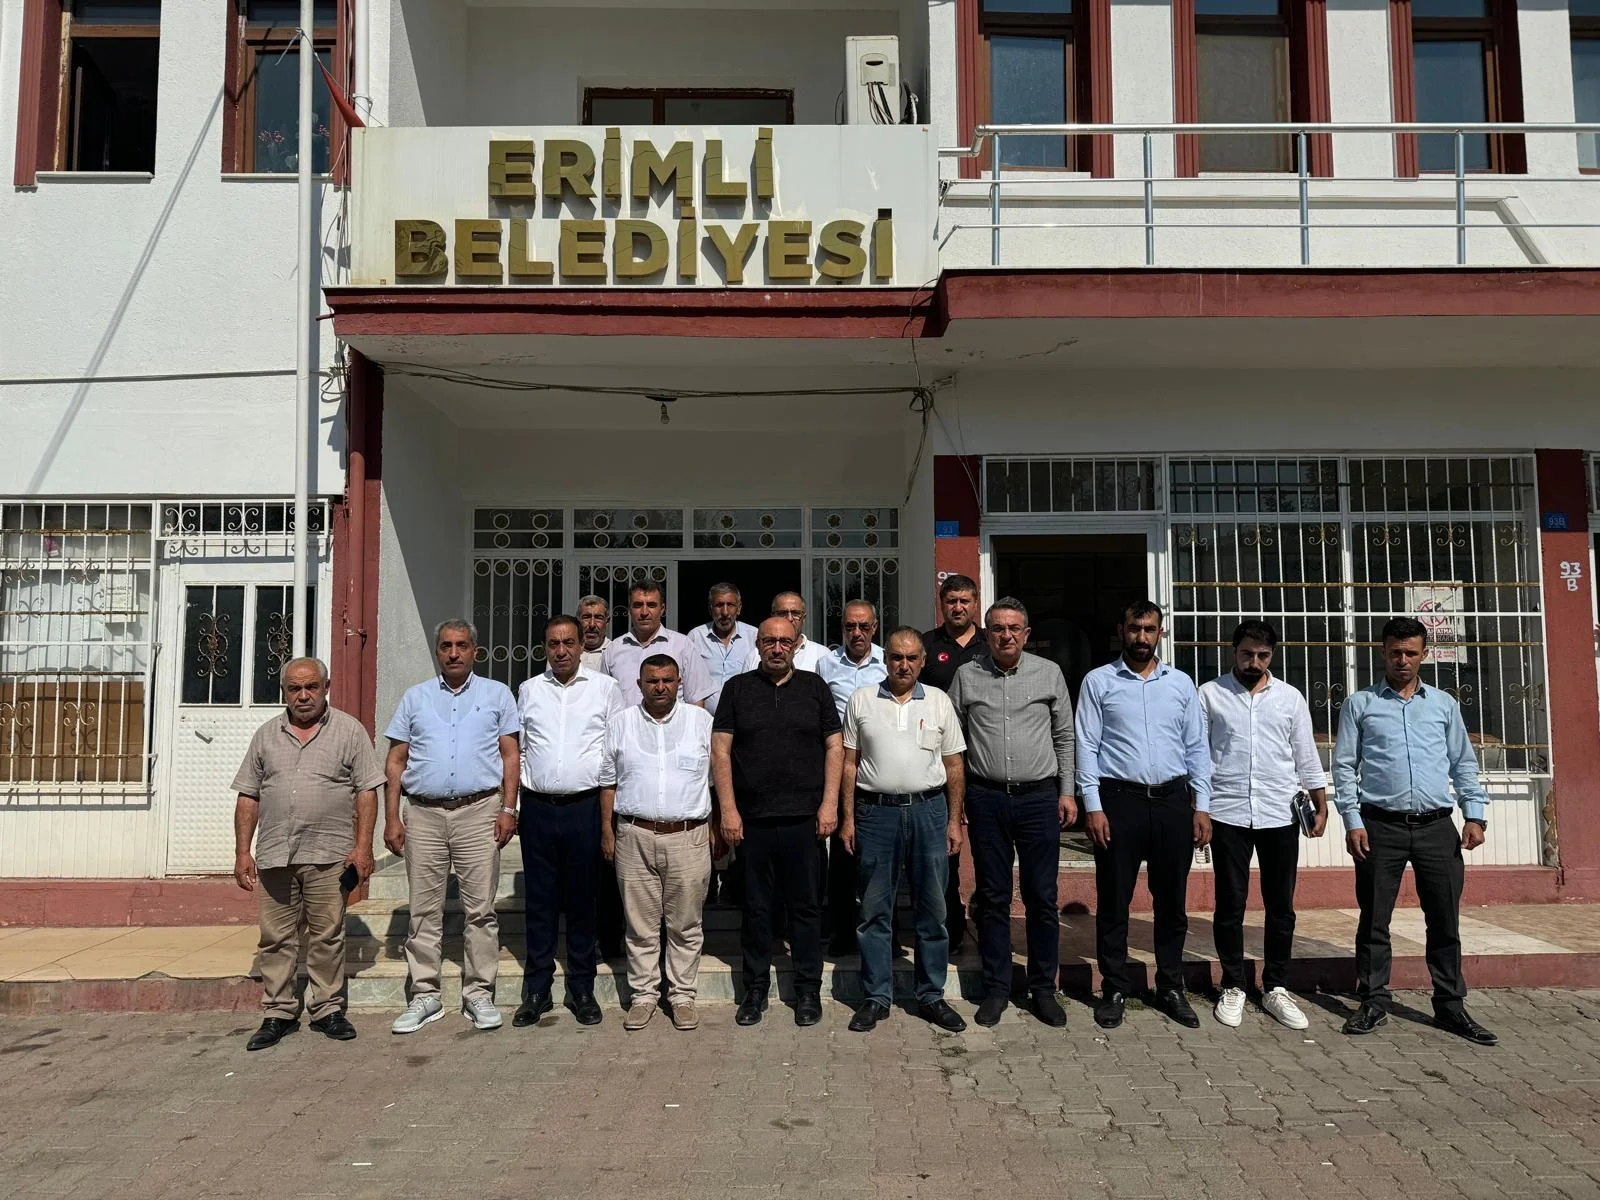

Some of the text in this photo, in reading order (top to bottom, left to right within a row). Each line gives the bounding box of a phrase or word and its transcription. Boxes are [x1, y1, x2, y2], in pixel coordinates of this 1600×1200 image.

[488, 127, 774, 201] ERİMLİ
[394, 206, 892, 283] BELEDİYESİ
[1560, 561, 1581, 576] 93
[1567, 578, 1578, 592] B
